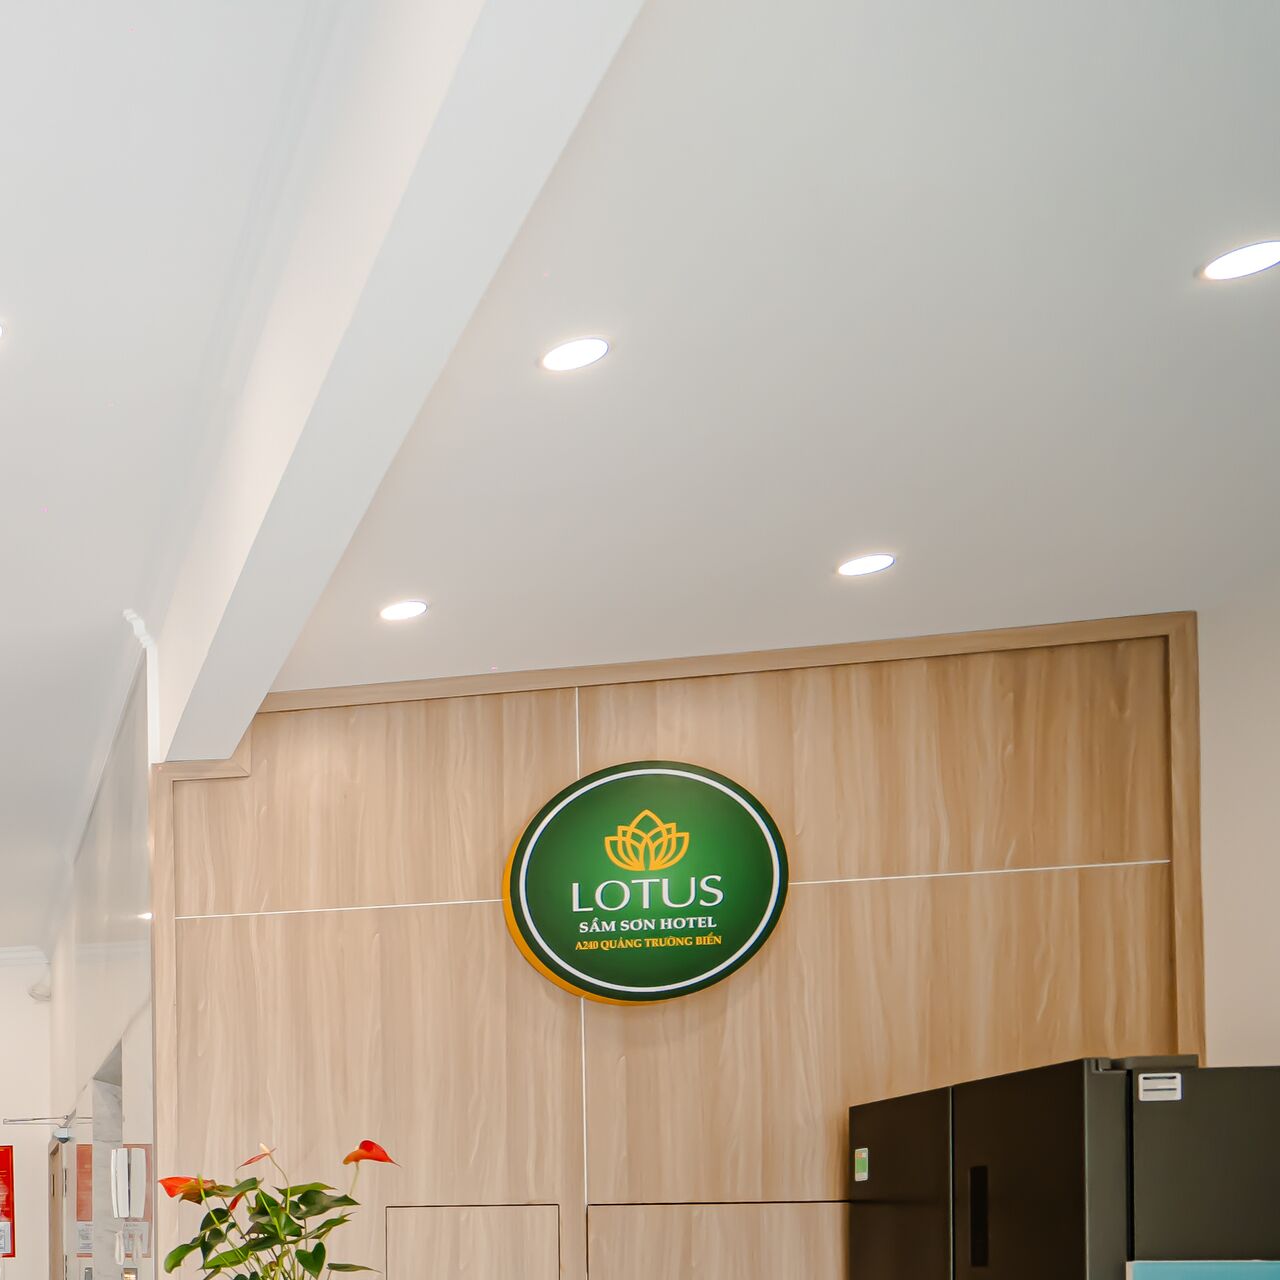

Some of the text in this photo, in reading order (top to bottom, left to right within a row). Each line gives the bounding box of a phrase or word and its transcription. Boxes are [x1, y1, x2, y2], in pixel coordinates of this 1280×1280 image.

[571, 874, 724, 912] LOTUS
[620, 918, 655, 931] SƠN
[660, 916, 717, 930] HOTEL
